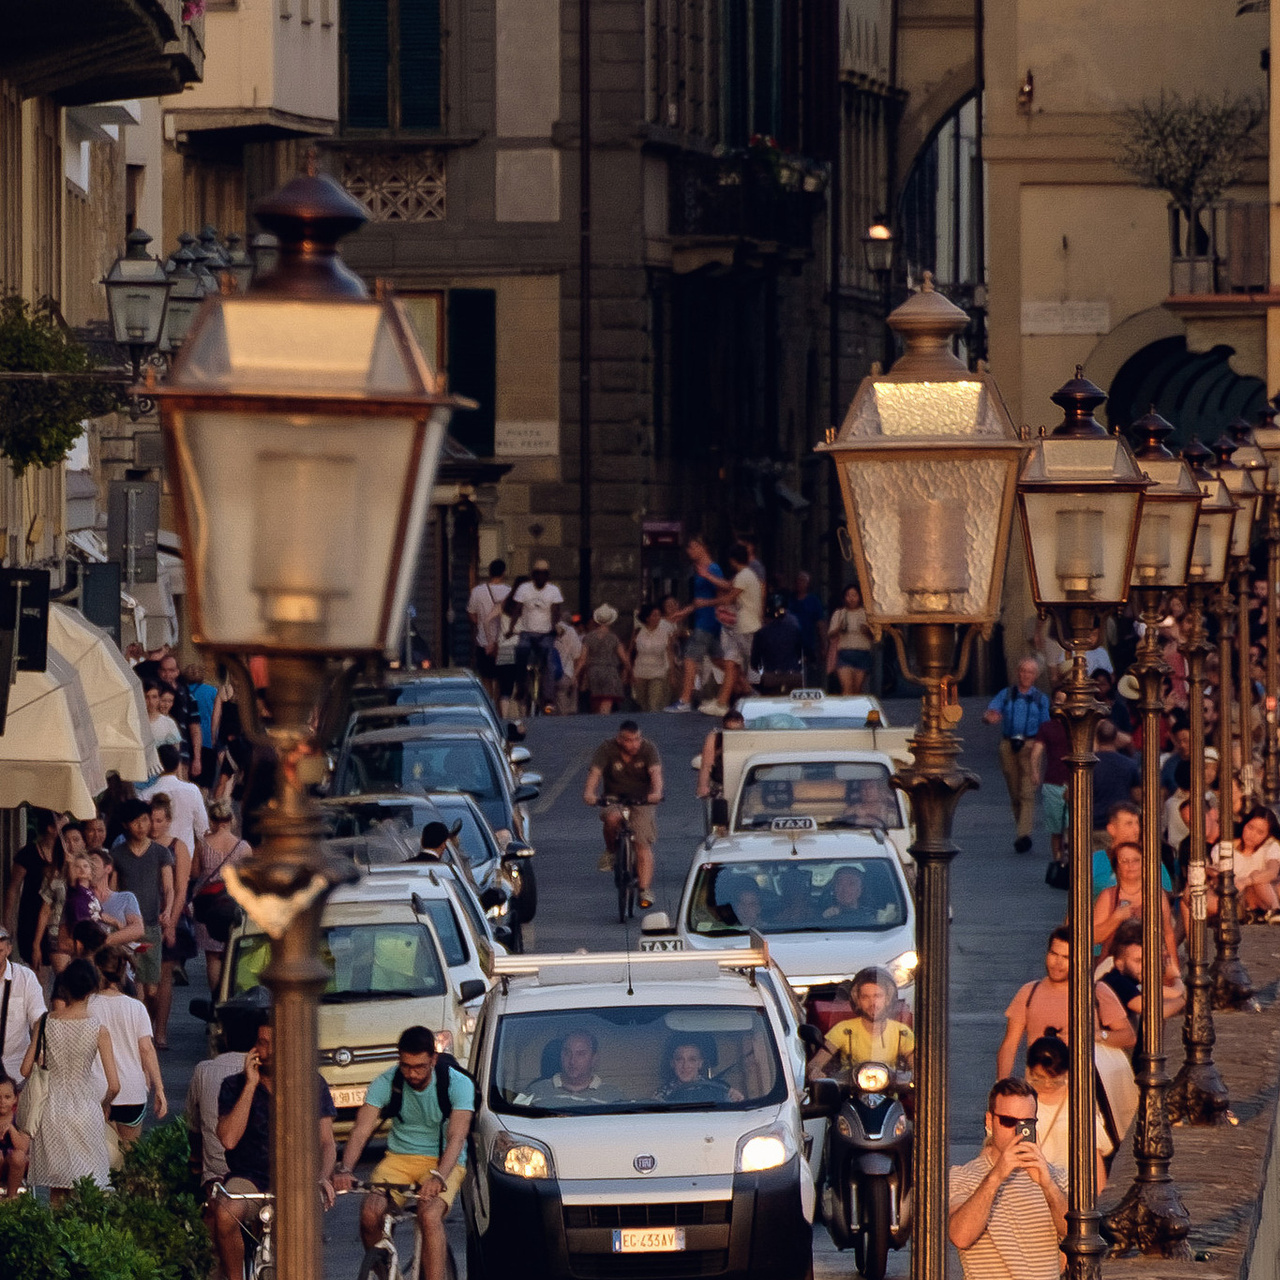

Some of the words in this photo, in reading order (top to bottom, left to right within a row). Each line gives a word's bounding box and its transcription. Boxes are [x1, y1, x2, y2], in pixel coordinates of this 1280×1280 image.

[792, 690, 822, 700] TAXI
[776, 819, 812, 830] TAXI
[642, 940, 683, 952] TAXI
